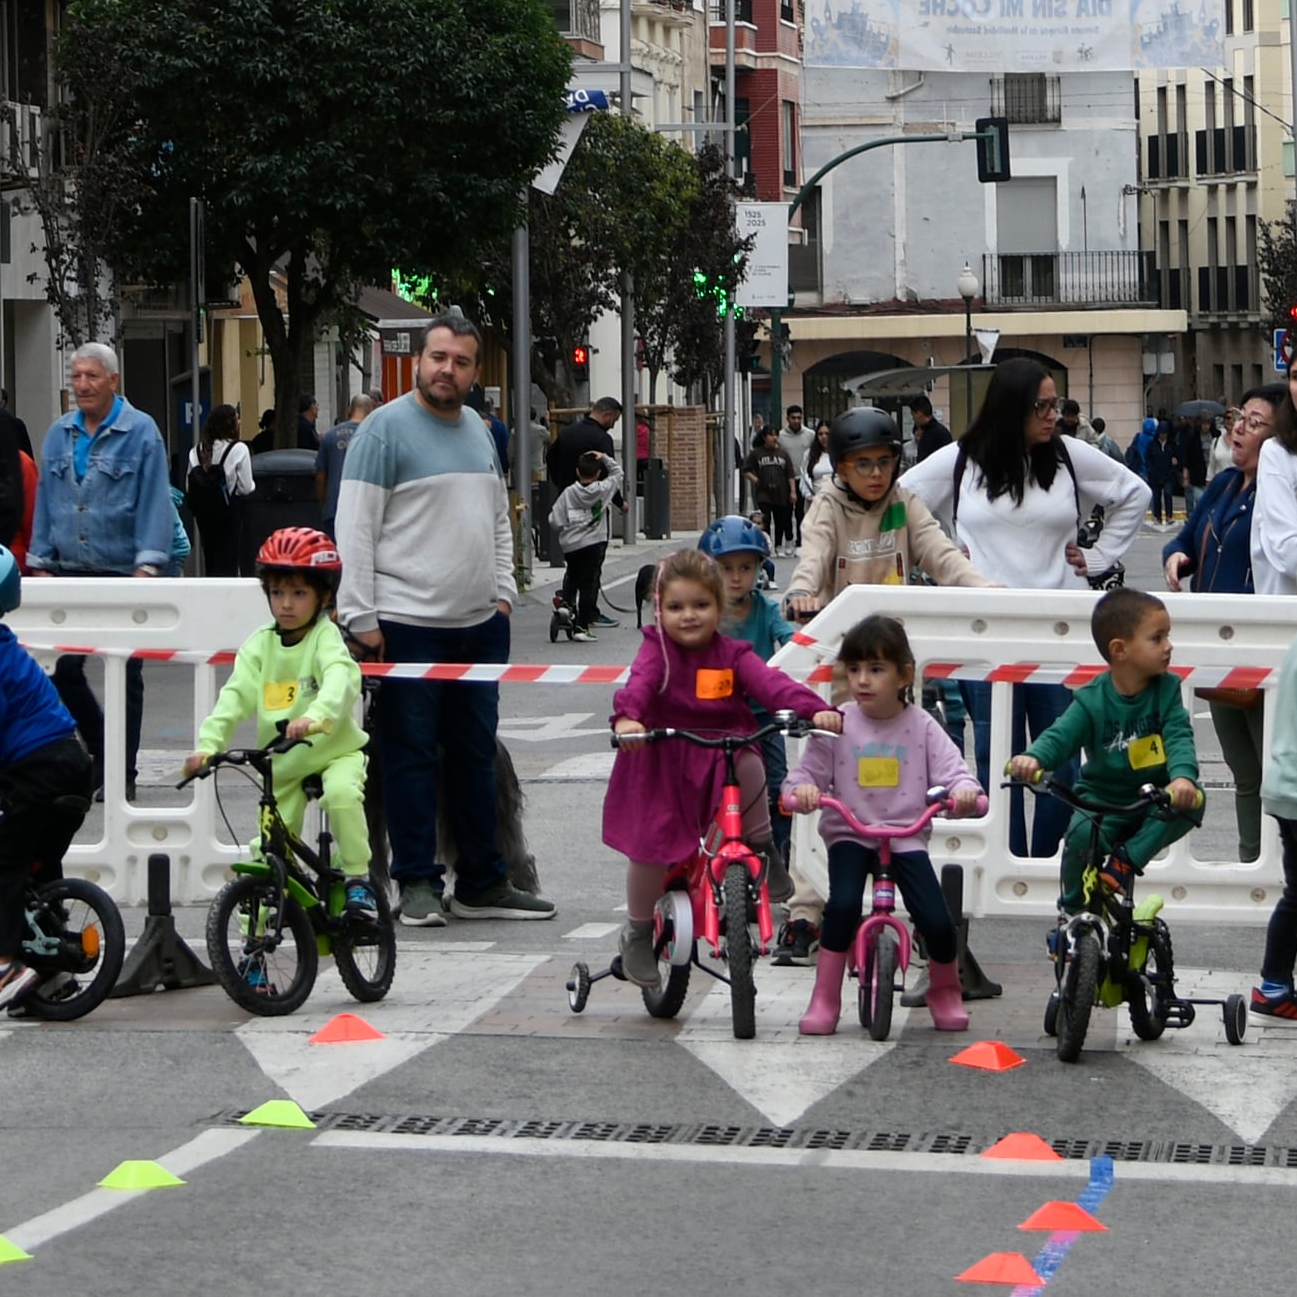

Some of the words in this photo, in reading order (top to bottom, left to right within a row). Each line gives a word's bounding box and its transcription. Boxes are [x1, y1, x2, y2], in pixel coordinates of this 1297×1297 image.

[747, 219, 766, 227] 2025
[286, 686, 295, 703] 3
[1149, 740, 1159, 755] 4
